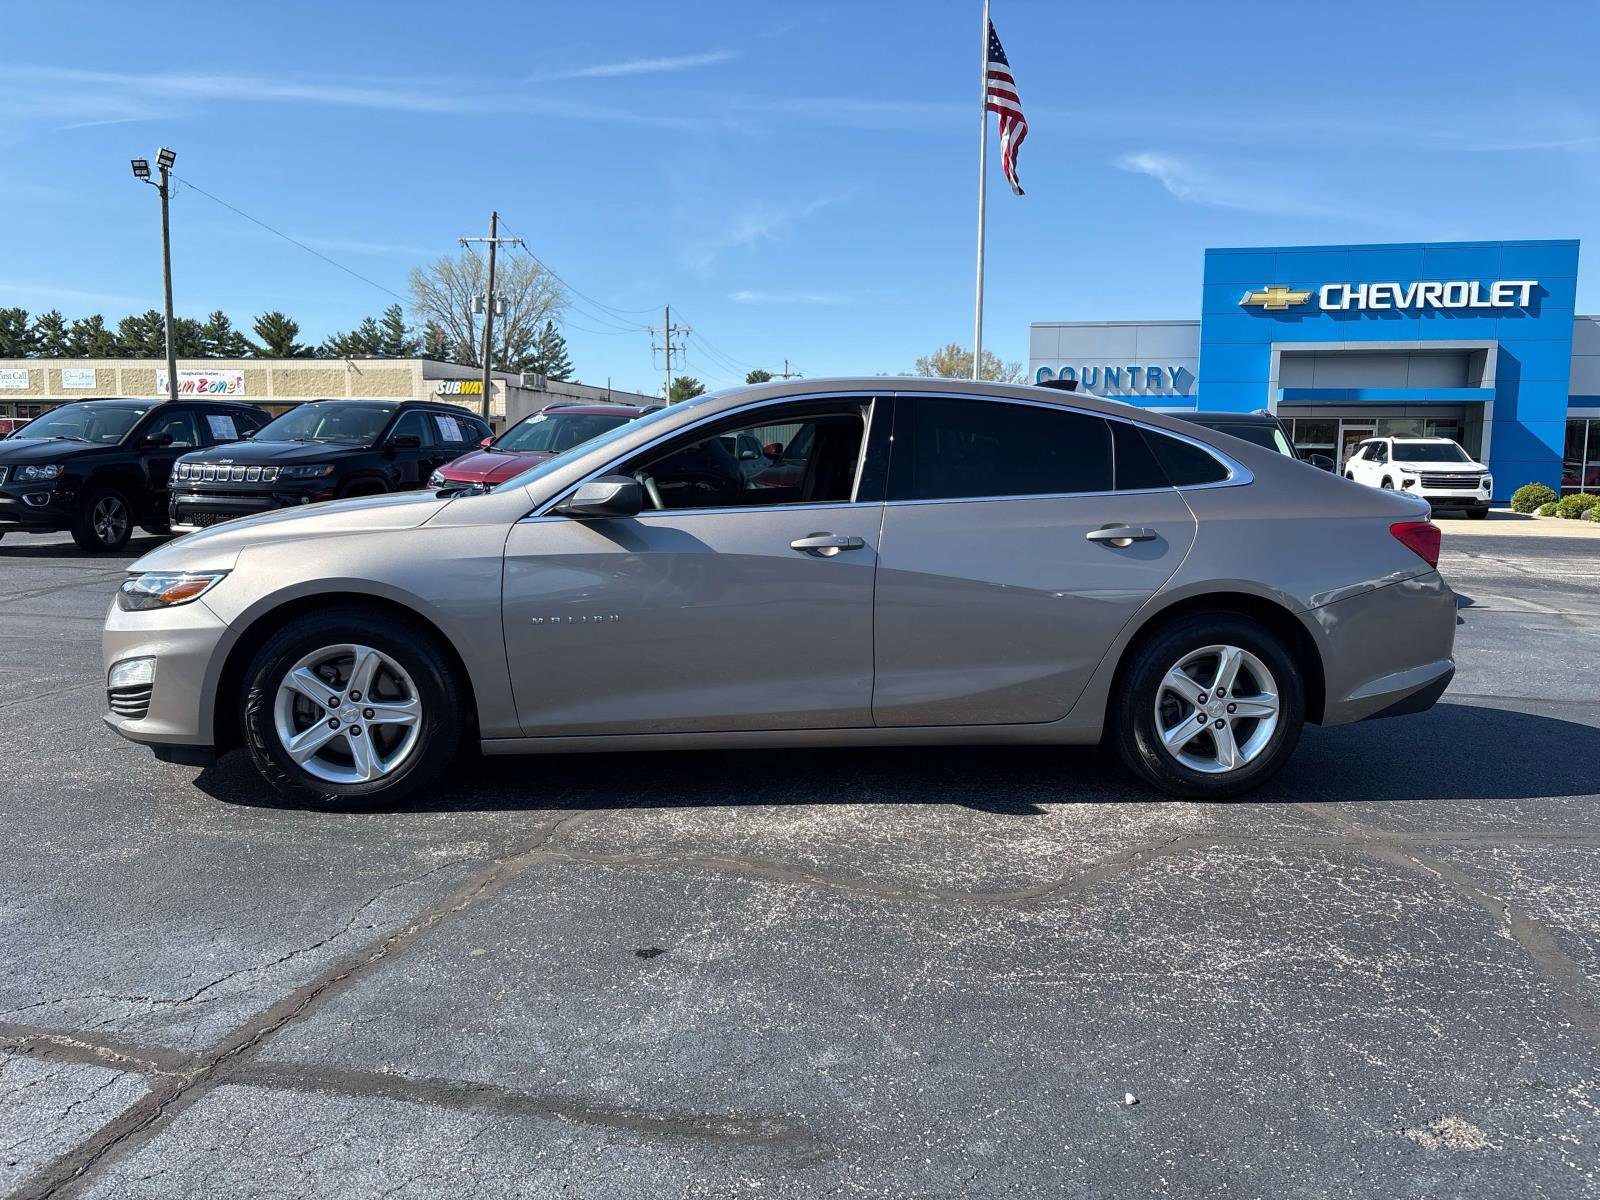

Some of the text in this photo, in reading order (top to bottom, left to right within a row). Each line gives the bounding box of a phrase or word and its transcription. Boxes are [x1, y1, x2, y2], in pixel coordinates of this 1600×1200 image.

[1319, 281, 1538, 310] CHEVROLET
[13, 371, 27, 380] Call
[1036, 366, 1183, 389] COUNTRY
[197, 378, 236, 394] Zone
